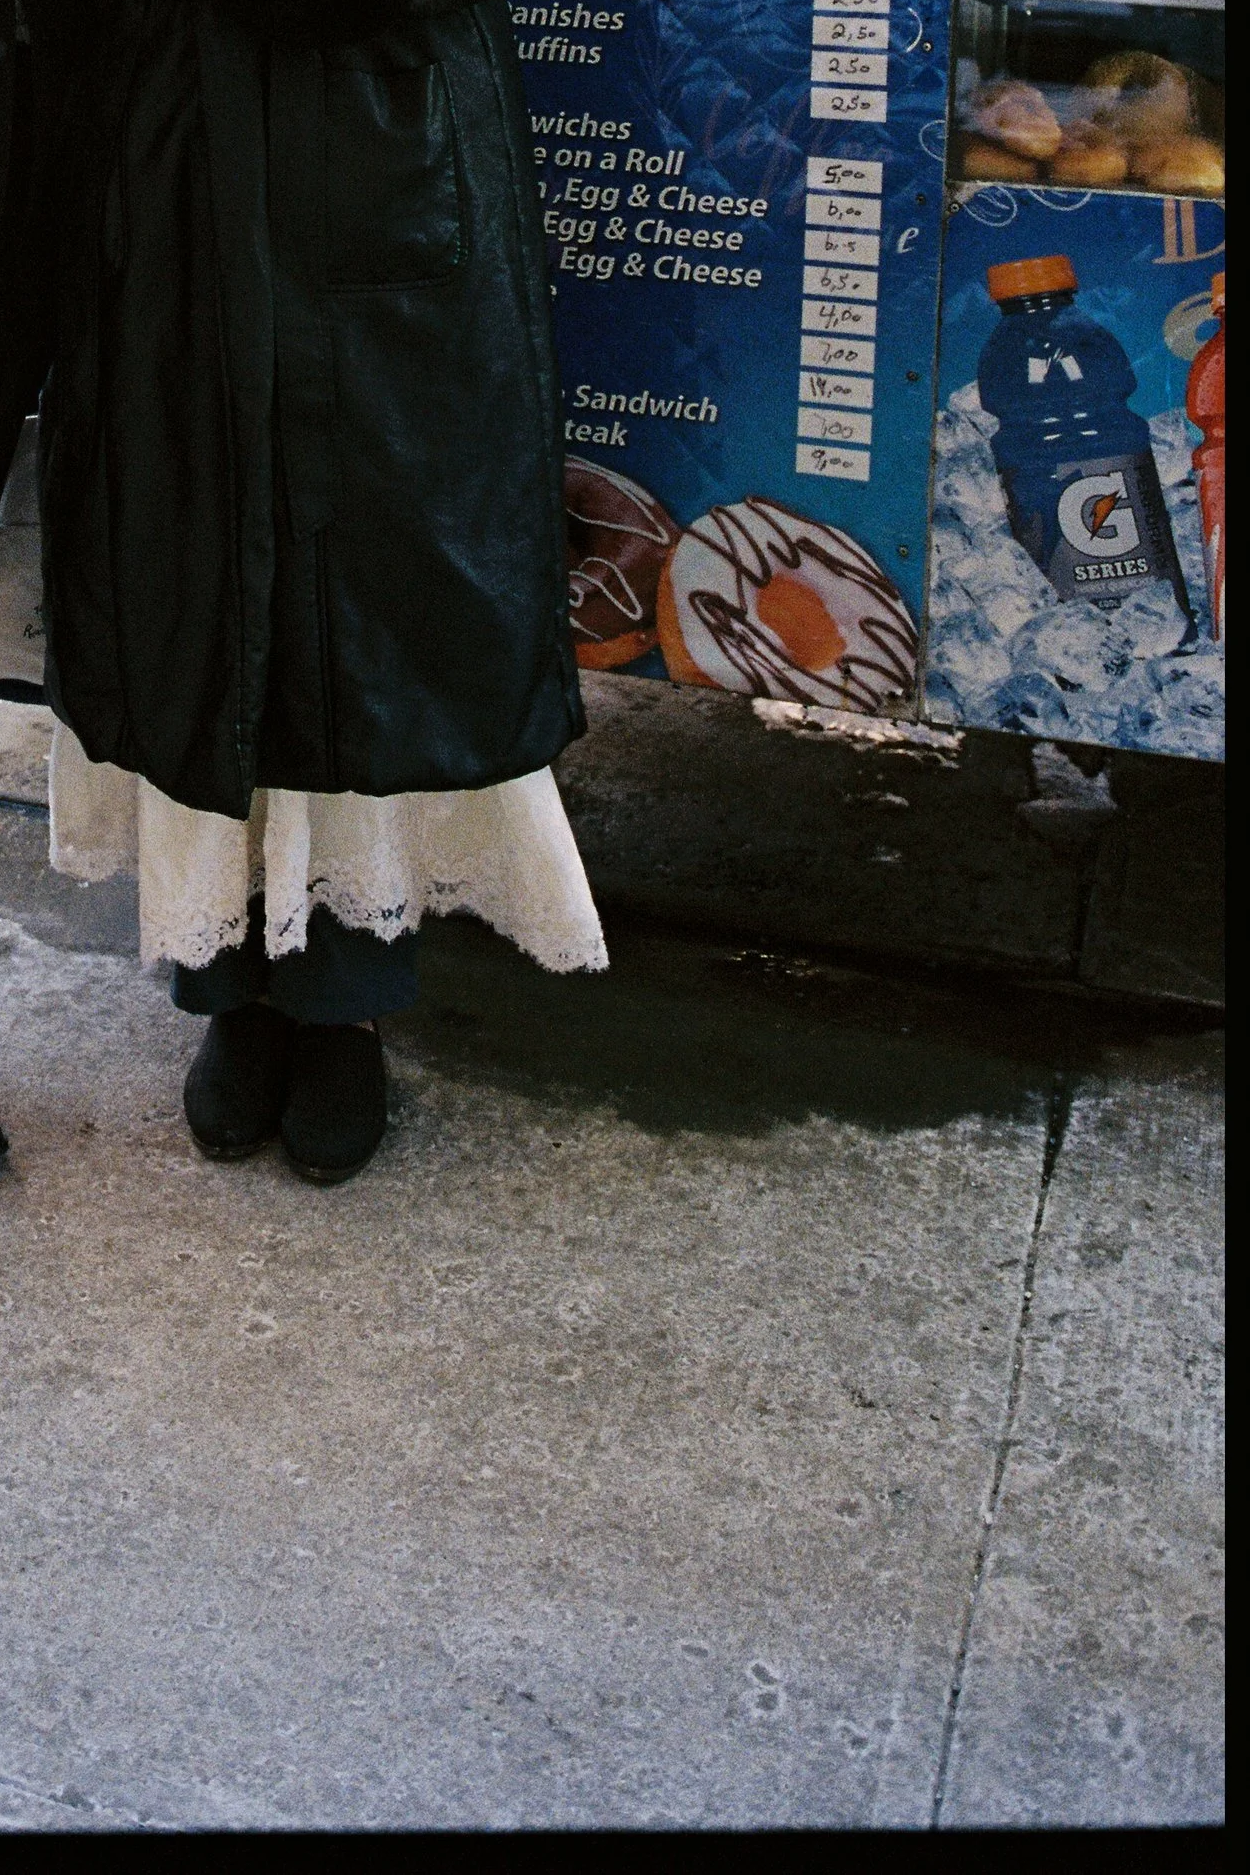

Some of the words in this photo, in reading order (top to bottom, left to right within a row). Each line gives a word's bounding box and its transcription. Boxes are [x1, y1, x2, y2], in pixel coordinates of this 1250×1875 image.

[507, 0, 625, 30] anishes
[514, 35, 603, 64] uffins
[528, 109, 632, 140] wiches
[554, 147, 593, 169] on
[600, 151, 617, 171] a
[625, 148, 685, 176] Roll
[822, 164, 865, 184] 5,00
[627, 183, 650, 208] &
[658, 185, 768, 218] Cheese
[543, 210, 597, 244] Egg
[604, 216, 627, 241] &
[634, 219, 744, 251] Cheese
[559, 246, 616, 280] Egg
[622, 252, 646, 277] &
[653, 255, 762, 287] Cheese
[819, 304, 862, 329] 4,00
[573, 384, 719, 423] Sandwich
[564, 419, 629, 447] teak
[1057, 470, 1141, 558] G
[1074, 558, 1149, 582] SERIES
